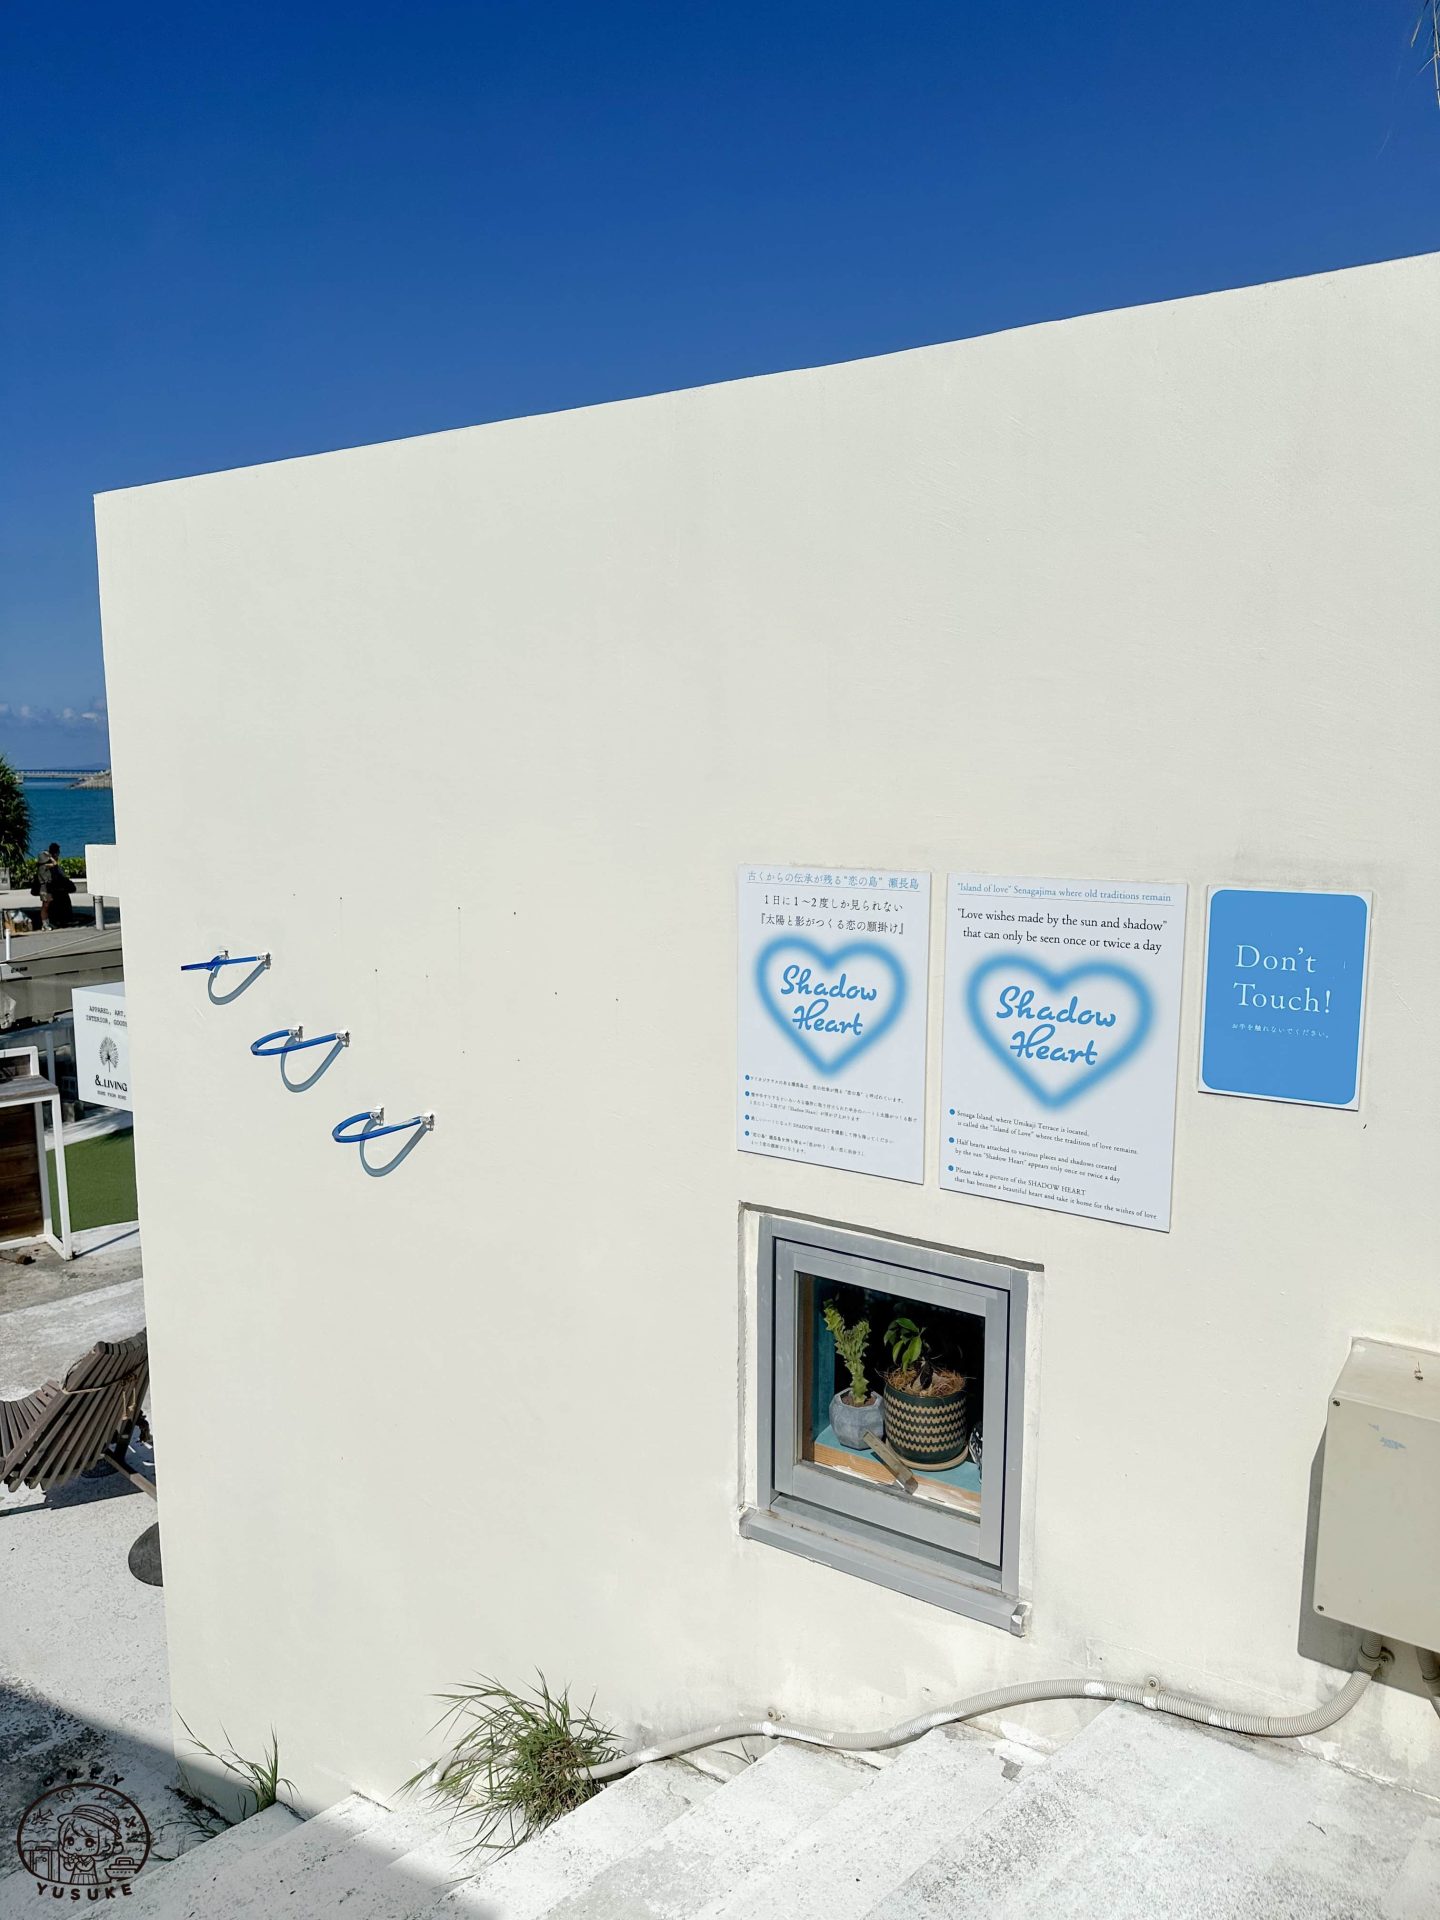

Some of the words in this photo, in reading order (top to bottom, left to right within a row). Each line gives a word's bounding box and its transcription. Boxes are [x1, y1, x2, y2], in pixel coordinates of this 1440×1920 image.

[1014, 886, 1056, 897] Senagajima
[1059, 888, 1082, 897] where
[1085, 890, 1097, 898] old
[1100, 891, 1139, 900] traditions
[1142, 893, 1171, 902] remain
[986, 910, 1014, 922] wishes
[1018, 913, 1043, 924] made
[1047, 914, 1059, 929] by
[1062, 915, 1078, 926] the
[1101, 918, 1120, 928] and
[964, 926, 981, 938] that
[984, 931, 1000, 939] can
[1003, 929, 1023, 945] only
[1027, 930, 1038, 942] be
[1041, 936, 1060, 944] seen
[1064, 937, 1086, 946] once
[1090, 939, 1100, 947] or
[1104, 937, 1131, 949] twice
[1144, 940, 1162, 955] day
[1235, 944, 1318, 974] Don't
[780, 964, 877, 1001] Shadow
[1233, 982, 1332, 1014] Touch!
[792, 998, 863, 1036] Heart
[996, 985, 1116, 1027] Shadow
[1010, 1023, 1098, 1065] Heart
[970, 1141, 985, 1149] hearts
[1070, 1159, 1094, 1168] shadows
